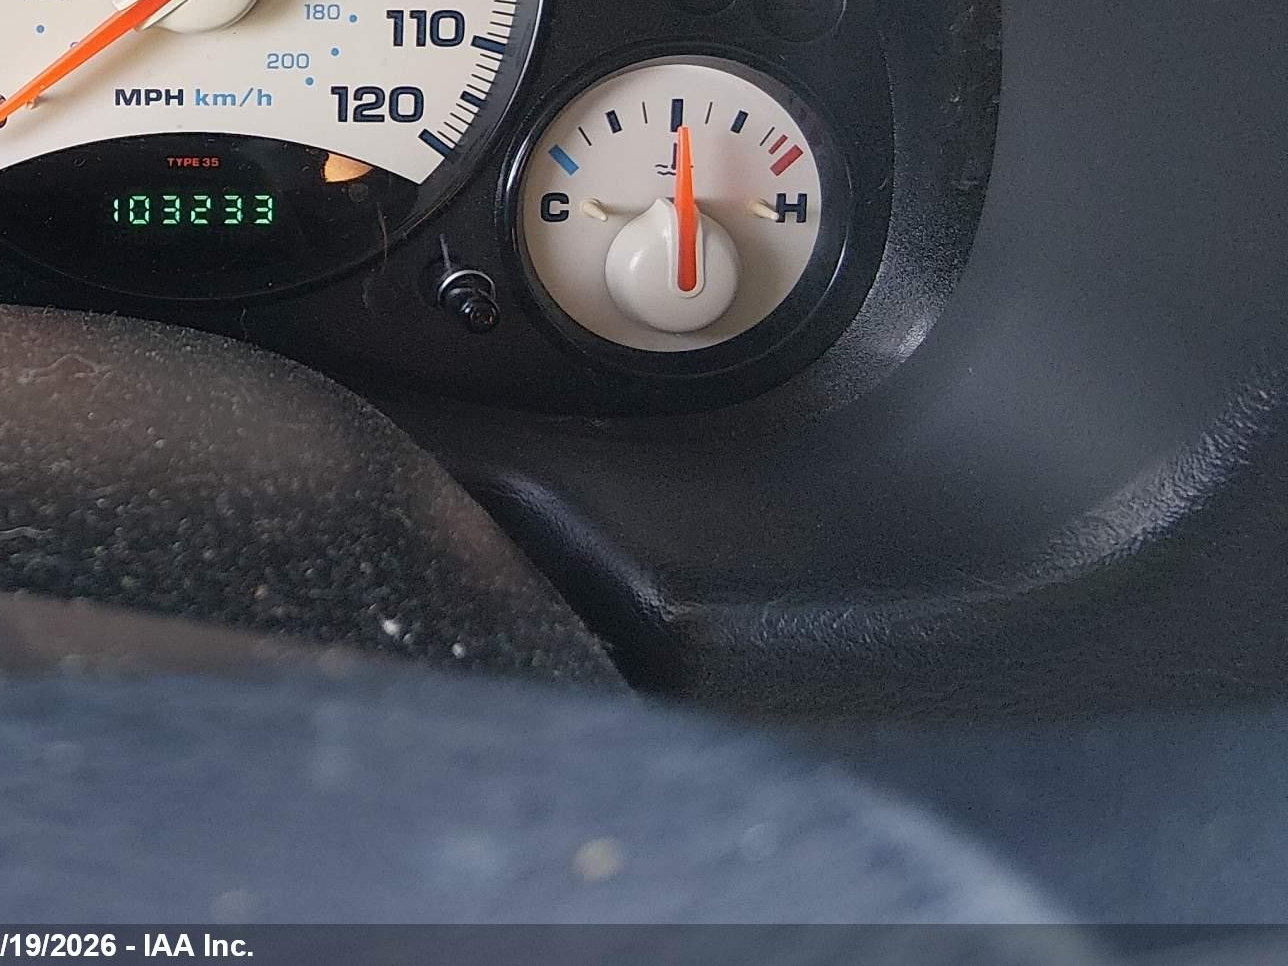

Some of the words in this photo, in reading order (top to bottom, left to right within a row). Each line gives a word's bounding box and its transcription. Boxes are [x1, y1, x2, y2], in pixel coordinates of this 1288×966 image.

[304, 3, 340, 19] 180
[387, 10, 465, 47] 110
[267, 53, 309, 69] 200
[115, 89, 183, 105] MPH
[196, 88, 271, 106] km/h
[331, 86, 424, 123] 120
[168, 158, 199, 166] TYPE
[203, 158, 218, 167] 35
[114, 196, 272, 224] 103233
[541, 193, 569, 222] C
[775, 193, 808, 223] H
